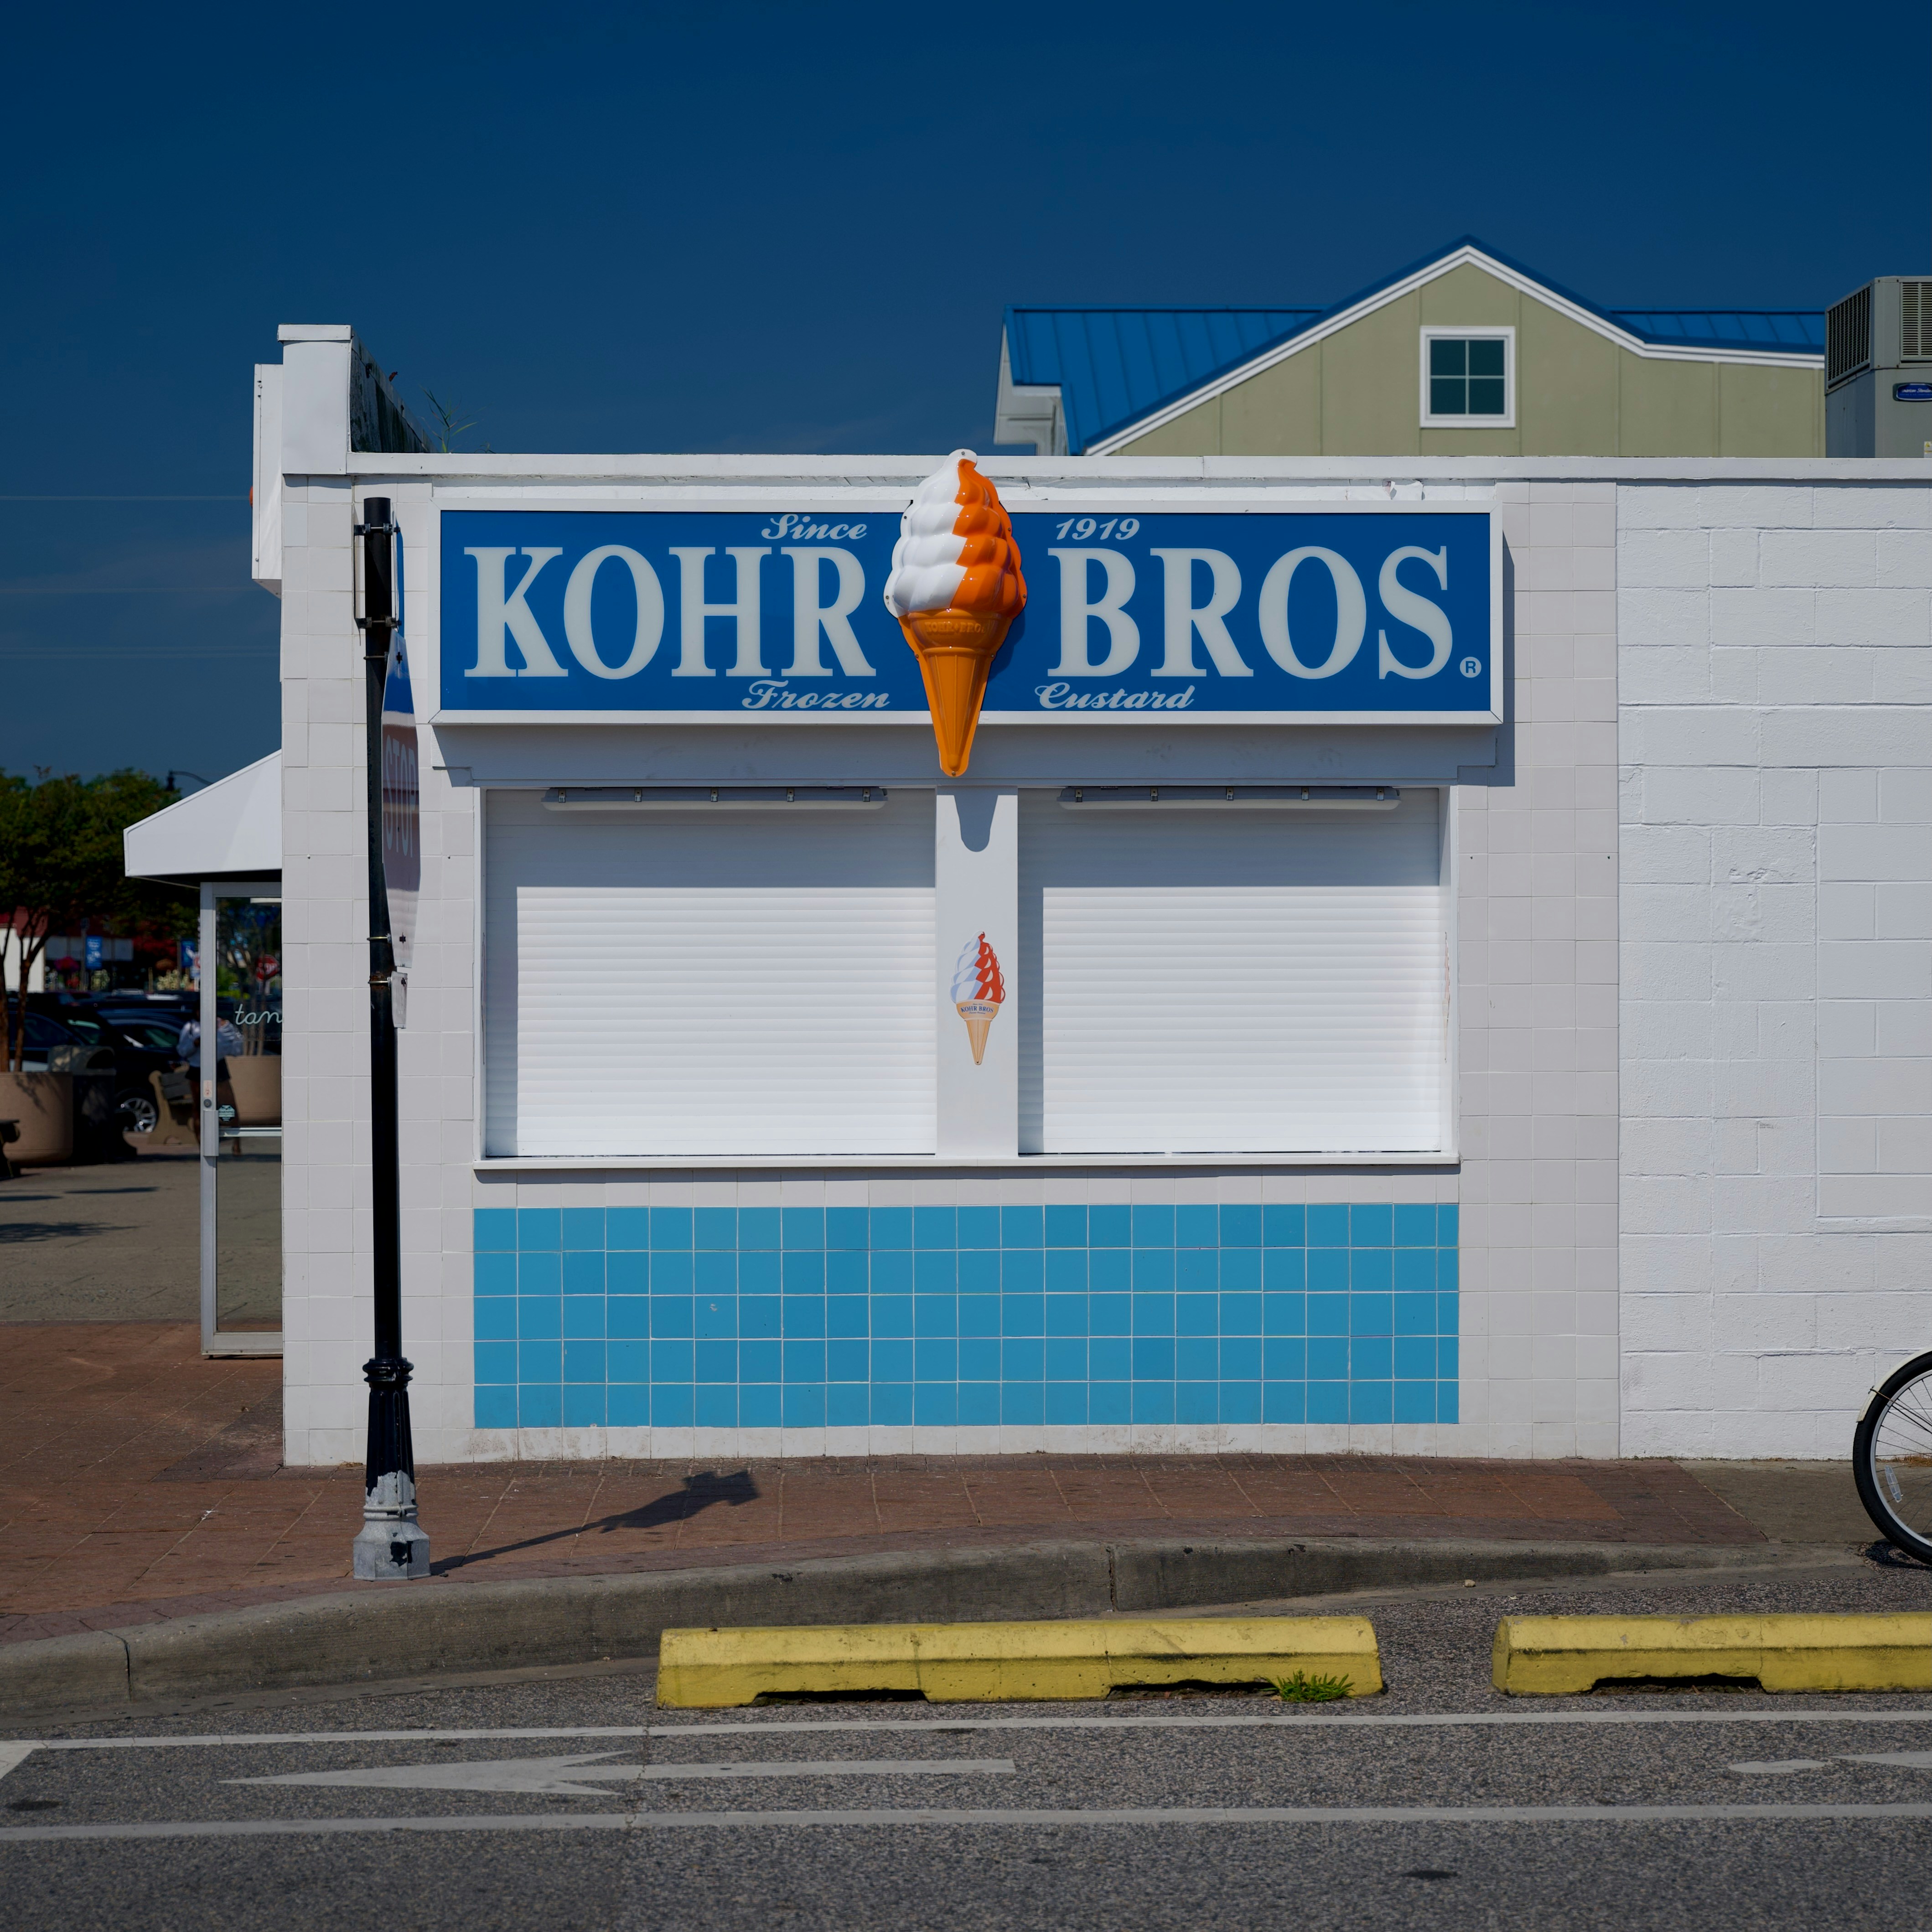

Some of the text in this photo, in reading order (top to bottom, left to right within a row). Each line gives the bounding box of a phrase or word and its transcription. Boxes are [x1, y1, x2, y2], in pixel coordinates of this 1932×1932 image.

[761, 514, 1140, 540] Since 1919
[464, 544, 876, 679] KOHR
[1047, 546, 1453, 679] BROS
[742, 680, 1195, 709] Frozen Custard
[386, 734, 416, 858] STOP
